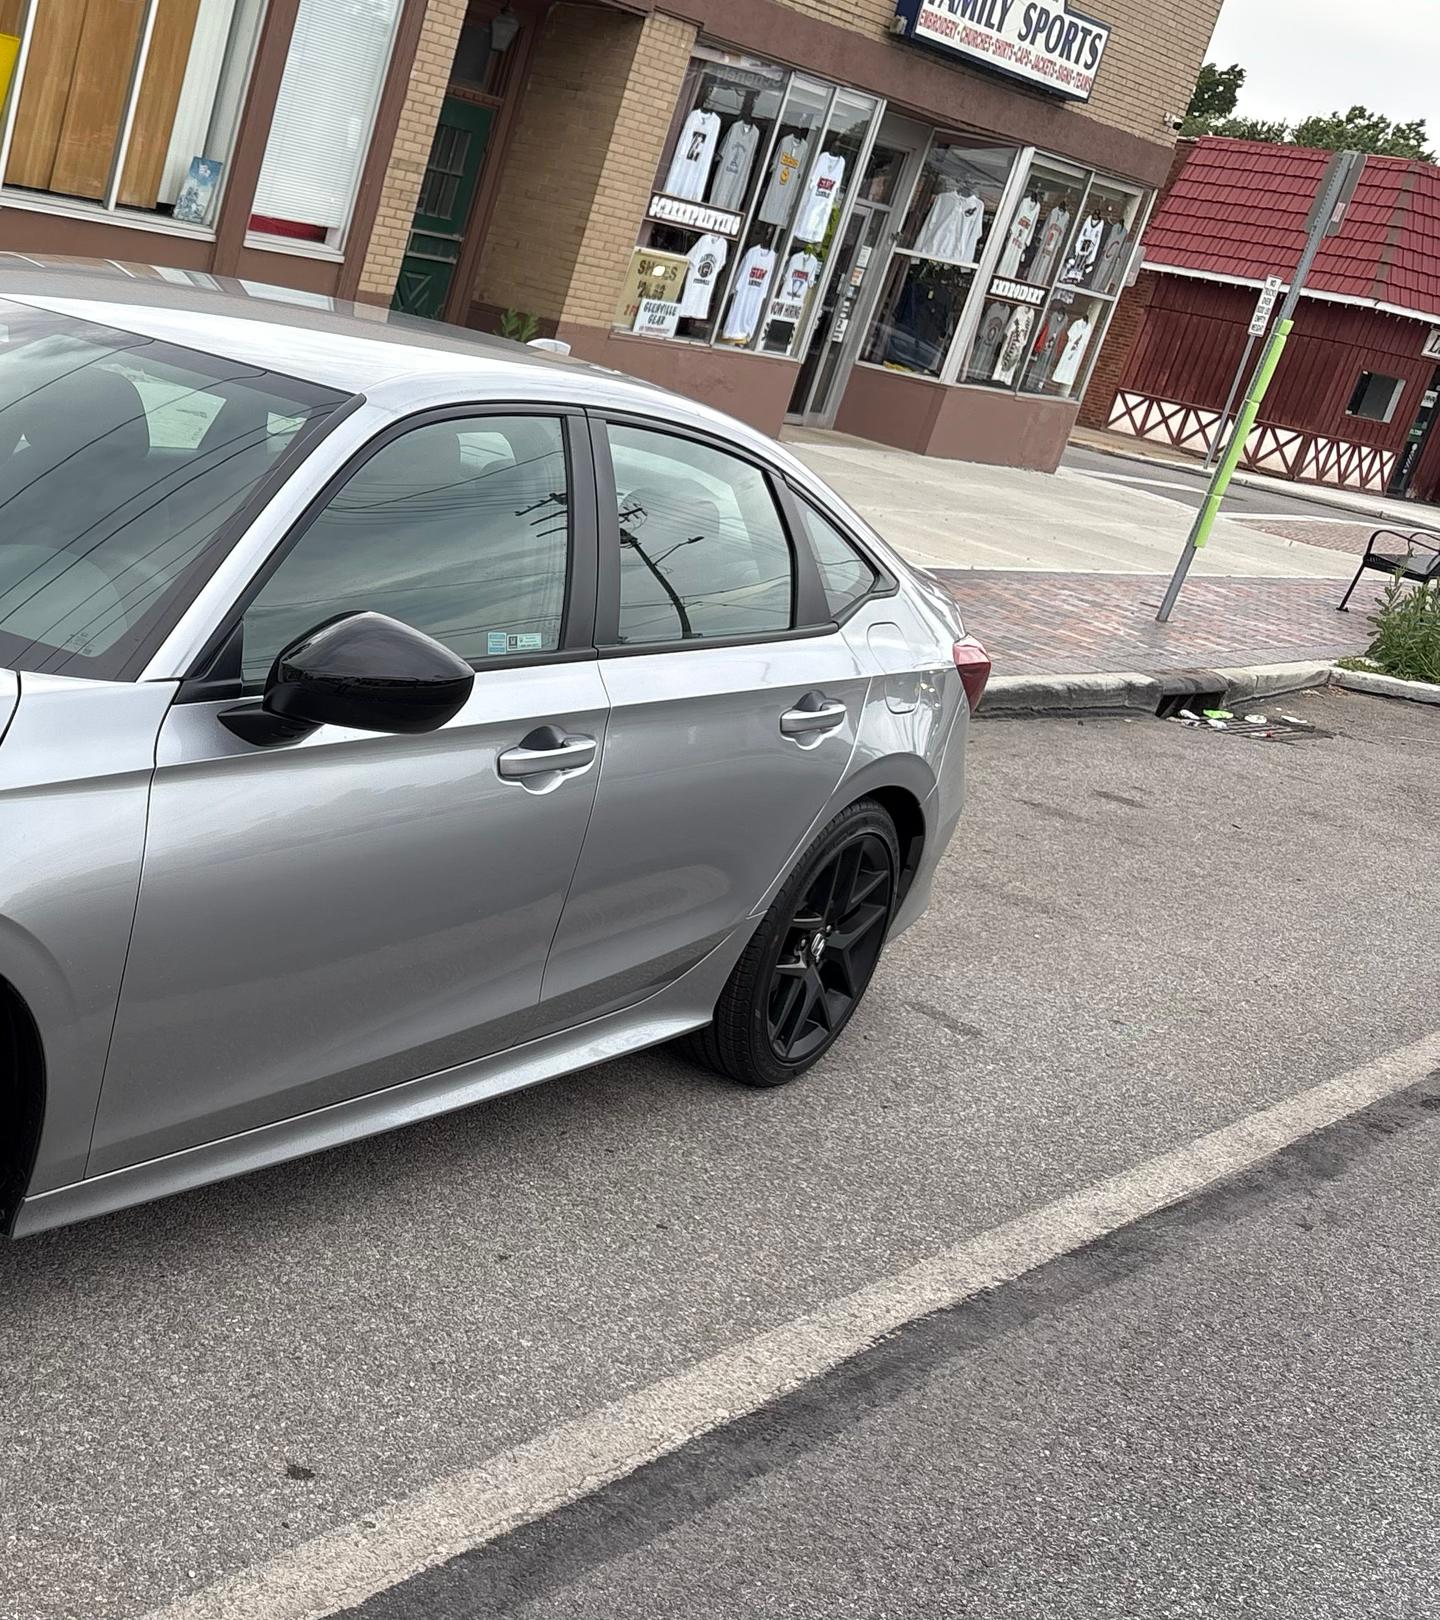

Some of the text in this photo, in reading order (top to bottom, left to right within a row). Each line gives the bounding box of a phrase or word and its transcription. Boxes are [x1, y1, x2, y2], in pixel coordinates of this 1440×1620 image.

[927, 0, 1103, 70] MILY SPORTS
[637, 260, 678, 281] SHES
